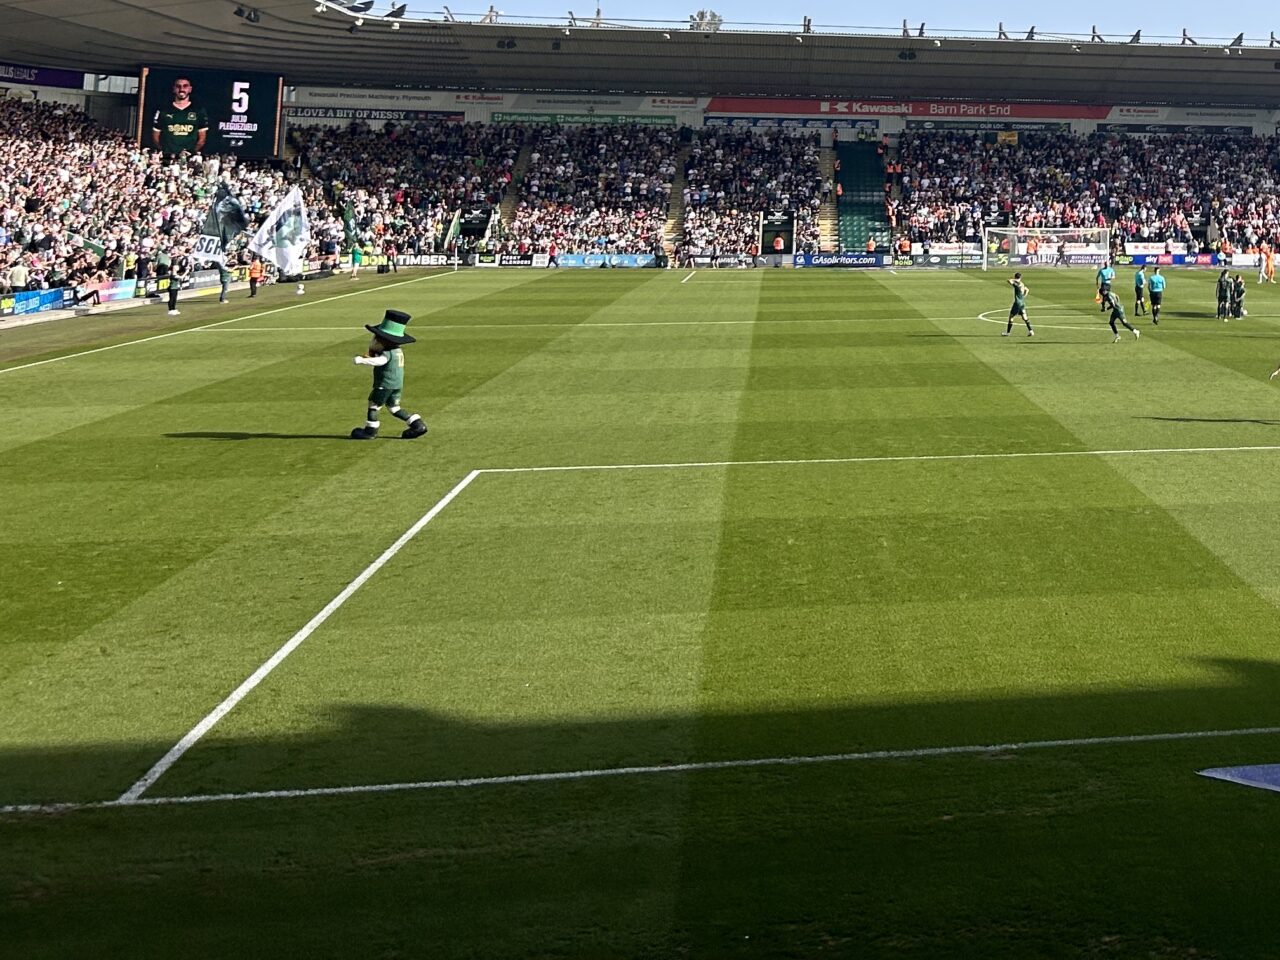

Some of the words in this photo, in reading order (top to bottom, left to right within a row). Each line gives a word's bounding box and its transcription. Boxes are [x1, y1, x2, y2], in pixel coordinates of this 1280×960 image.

[231, 81, 250, 114] 5
[402, 93, 431, 102] Plymouth
[853, 103, 912, 113] Kawasaki
[930, 103, 957, 114] Barn
[960, 104, 986, 114] Park
[990, 104, 1010, 115] End
[297, 108, 325, 117] LOVE
[327, 109, 337, 118] A
[338, 109, 355, 118] BIT
[356, 110, 369, 119] OF
[370, 111, 406, 120] MESSY
[361, 255, 388, 265] BON
[396, 255, 447, 265] TIMBER
[812, 256, 876, 265] GAsolicitors.com
[1145, 255, 1158, 263] sky
[1185, 255, 1197, 263] sky
